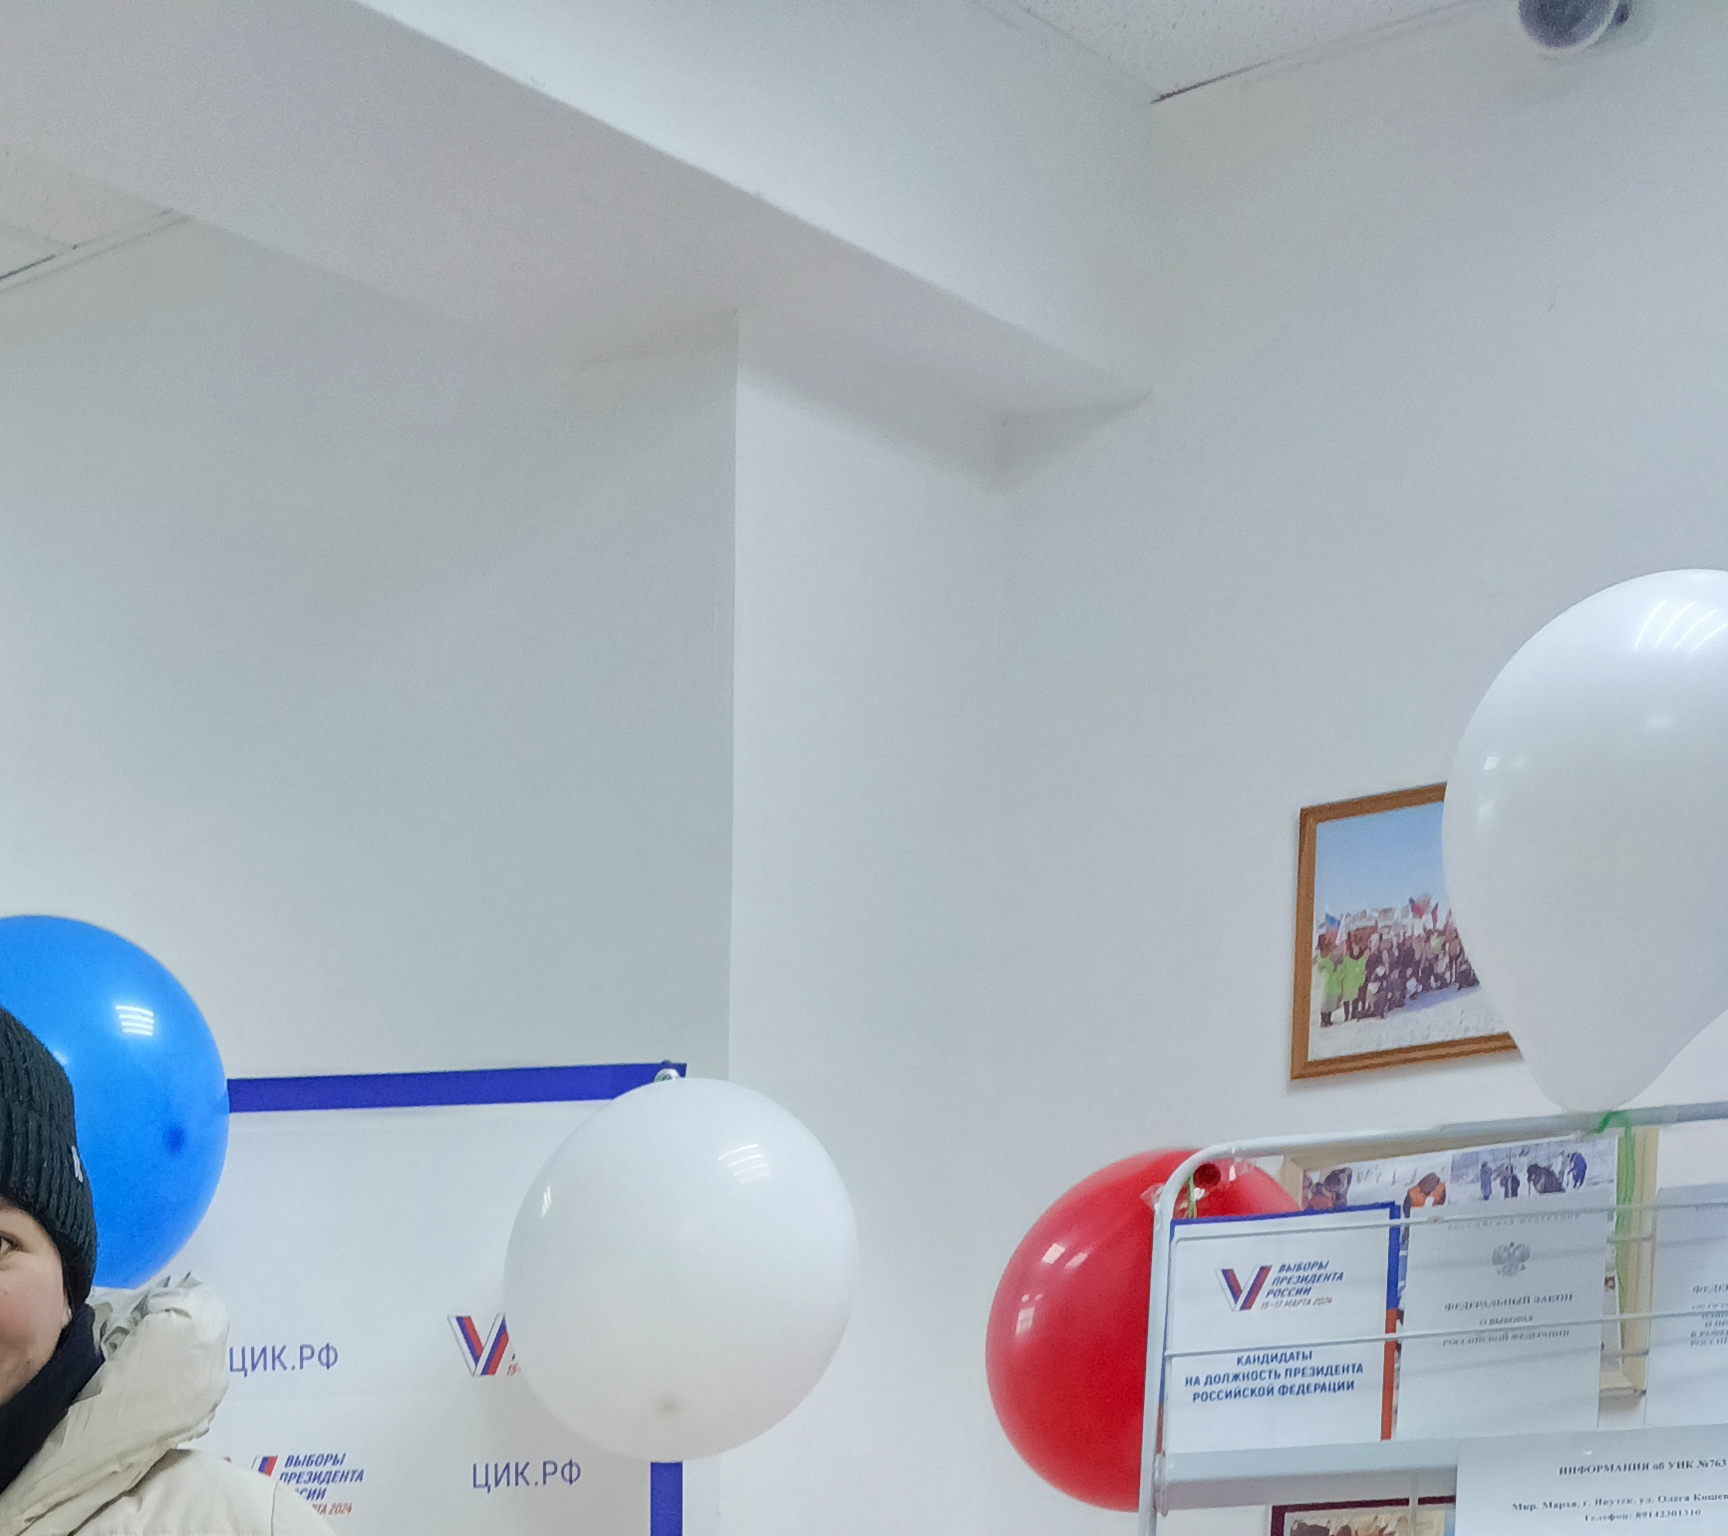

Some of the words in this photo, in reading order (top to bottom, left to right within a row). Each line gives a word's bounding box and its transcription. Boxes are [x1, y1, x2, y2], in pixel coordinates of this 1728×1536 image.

[1278, 1260, 1329, 1273] ВЫБОРЫ
[1272, 1271, 1344, 1286] ПРЕЗИДЕНТА
[1266, 1287, 1312, 1299] РОССИИ
[229, 1343, 338, 1377] ЦИК.РФ
[1237, 1351, 1313, 1366] КАНДИДАТЫ
[1185, 1376, 1200, 1387] НА
[1204, 1369, 1281, 1387] ДОЛЖНОСТЬ
[1284, 1363, 1364, 1378] ПРЕЗИДЕНТА
[1192, 1385, 1274, 1403] РОССИЙСКОЙ
[1277, 1380, 1355, 1396] ФЕДЕРАЦИИ
[285, 1453, 346, 1468] ВЫБОРЫ
[1668, 1459, 1693, 1470] УИК
[279, 1469, 365, 1485] ПРЕЗИДЕНТА
[473, 1459, 581, 1494] ЦИК.РФ
